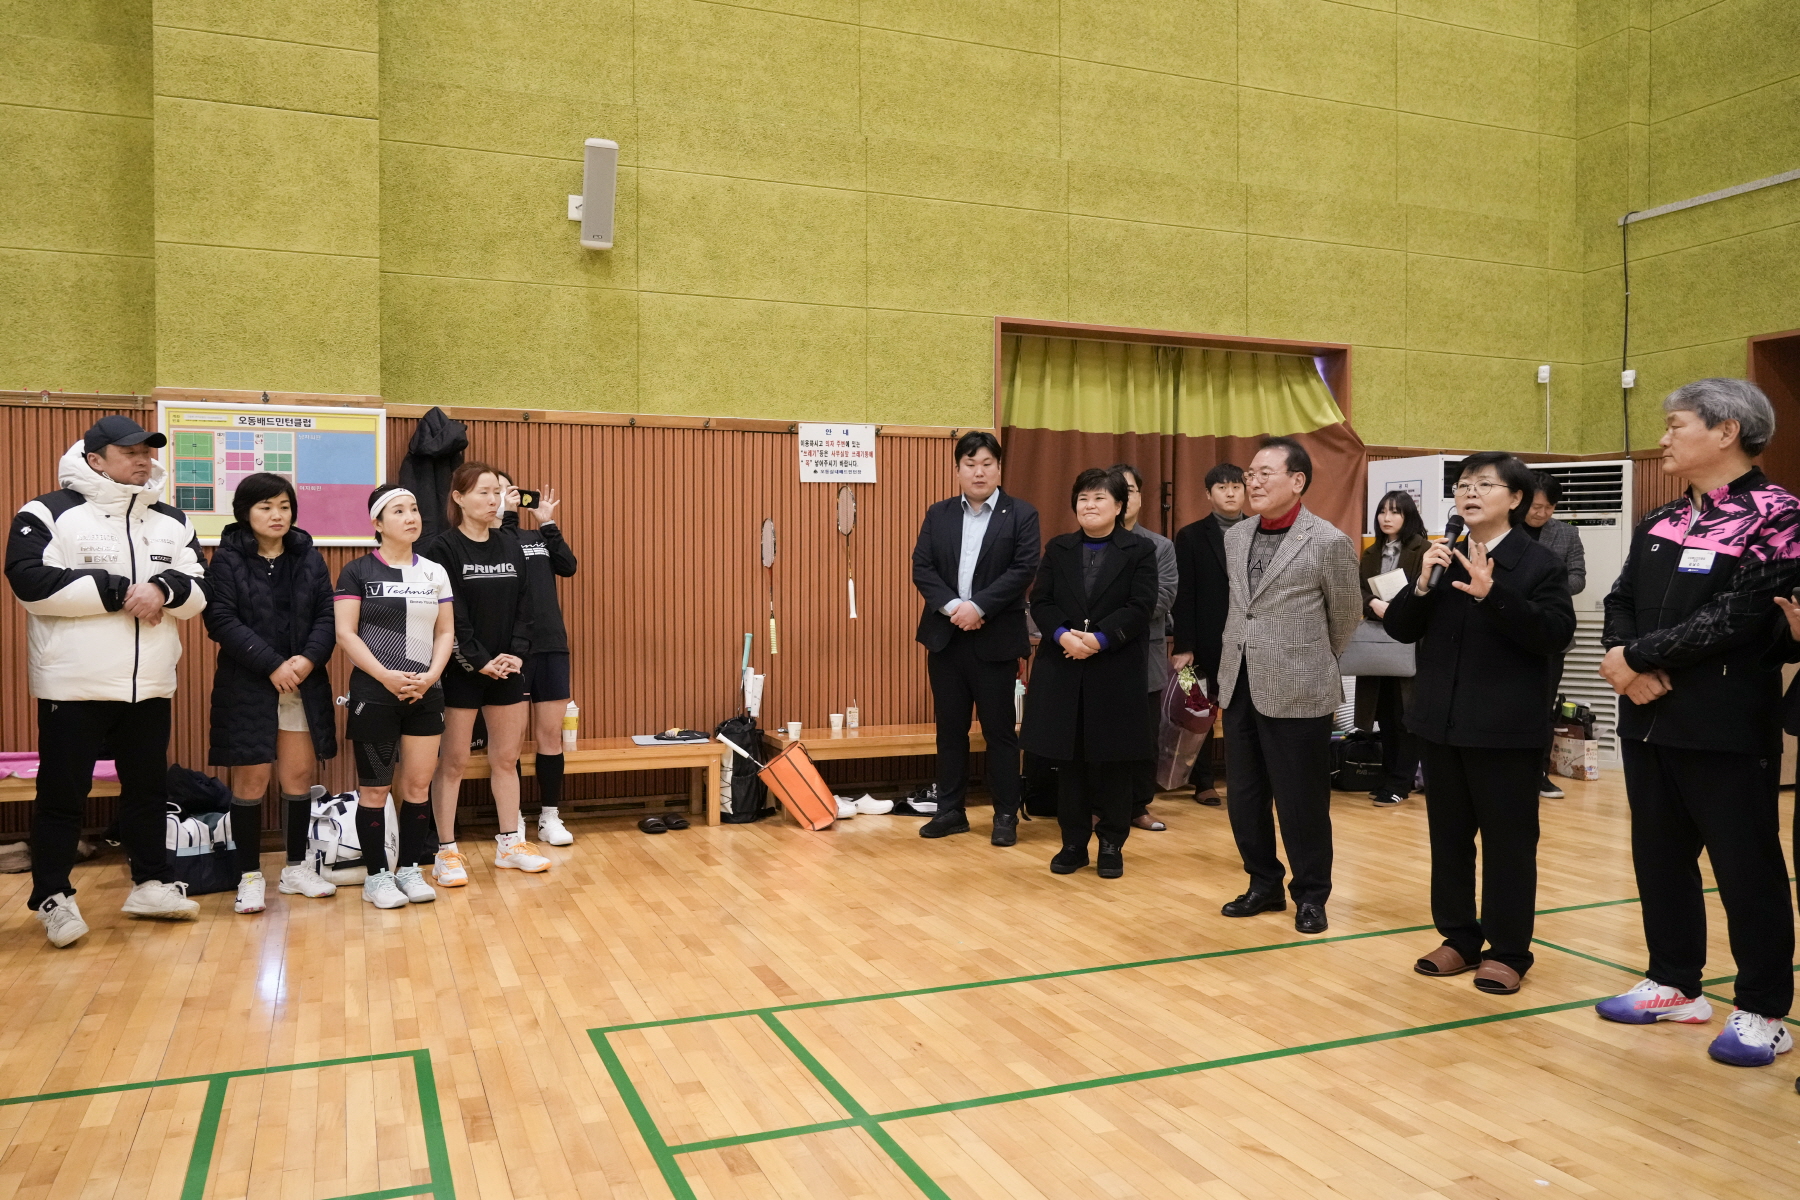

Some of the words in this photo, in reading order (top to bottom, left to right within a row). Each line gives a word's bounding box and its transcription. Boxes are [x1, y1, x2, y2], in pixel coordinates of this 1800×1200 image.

[238, 416, 312, 428] 오동배드민턴클럽
[462, 562, 517, 574] PRIMIQ
[386, 584, 434, 595] Technist
